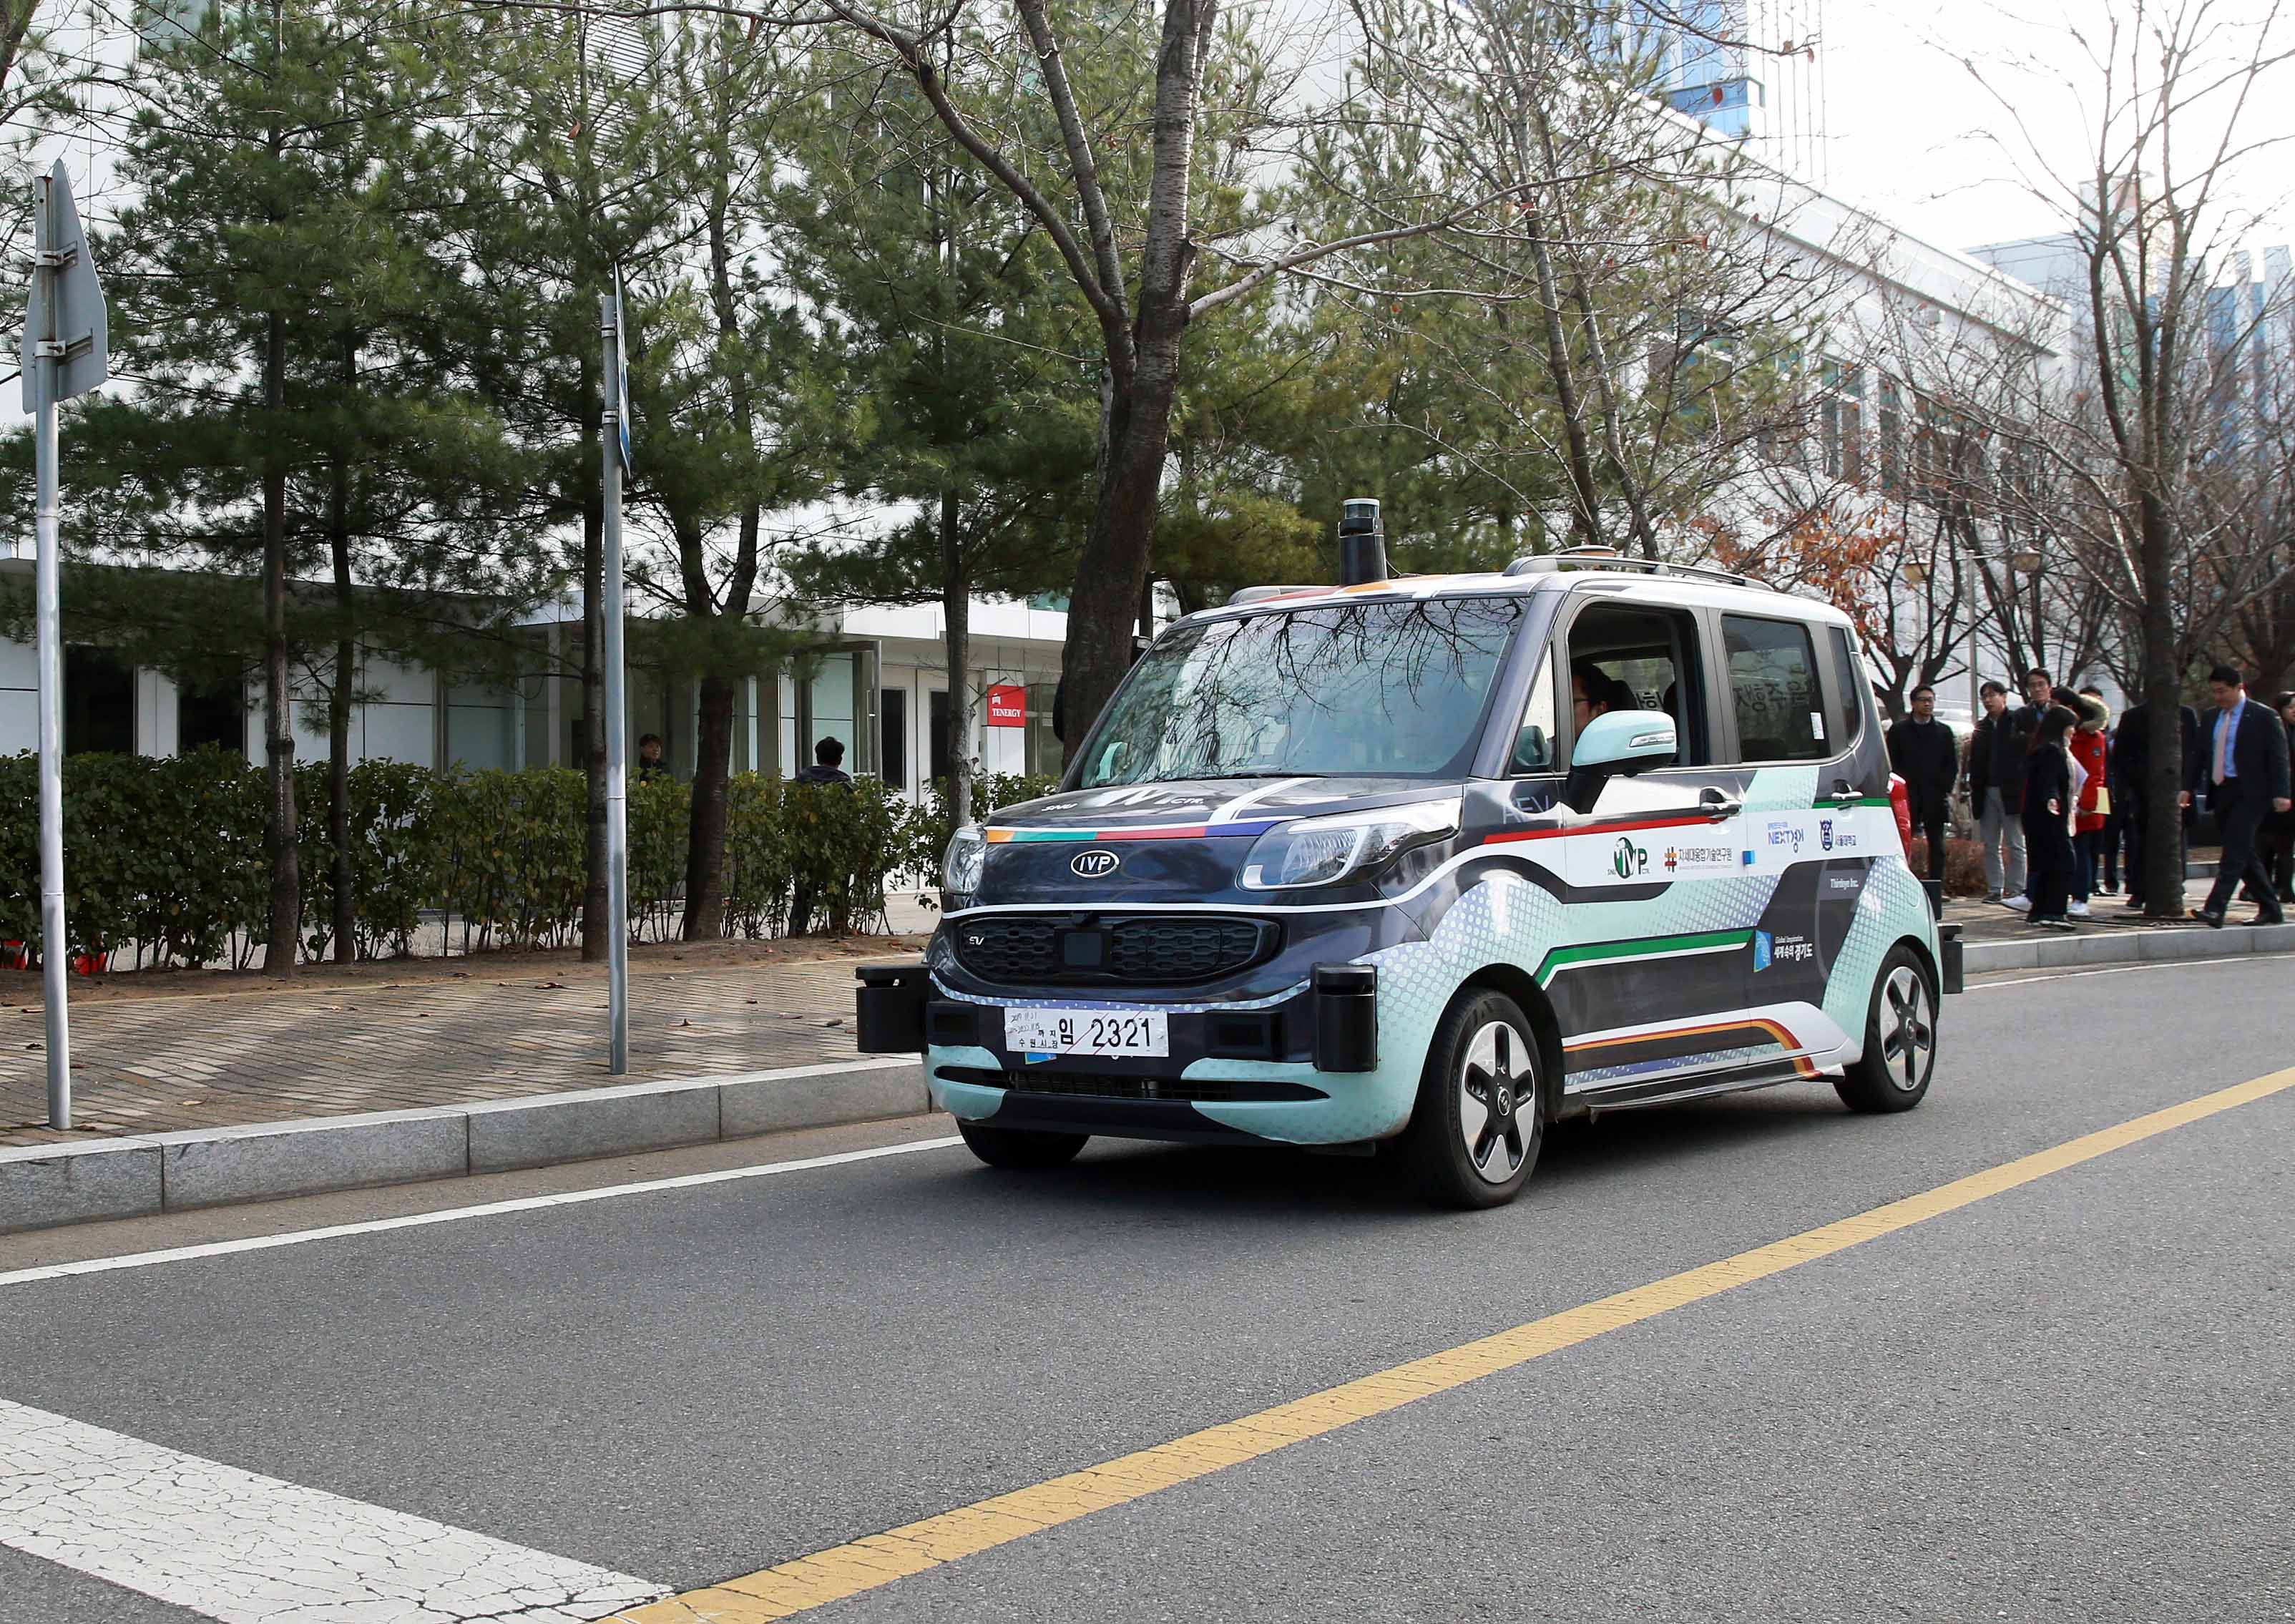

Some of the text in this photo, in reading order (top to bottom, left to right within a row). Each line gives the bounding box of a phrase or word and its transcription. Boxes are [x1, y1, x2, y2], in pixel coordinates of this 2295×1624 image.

[992, 708, 1021, 718] TENERGY
[1080, 856, 1111, 872] IVP
[969, 936, 984, 945] EV
[1794, 943, 1813, 961] 경기도
[1058, 1017, 1150, 1048] 임 2321
